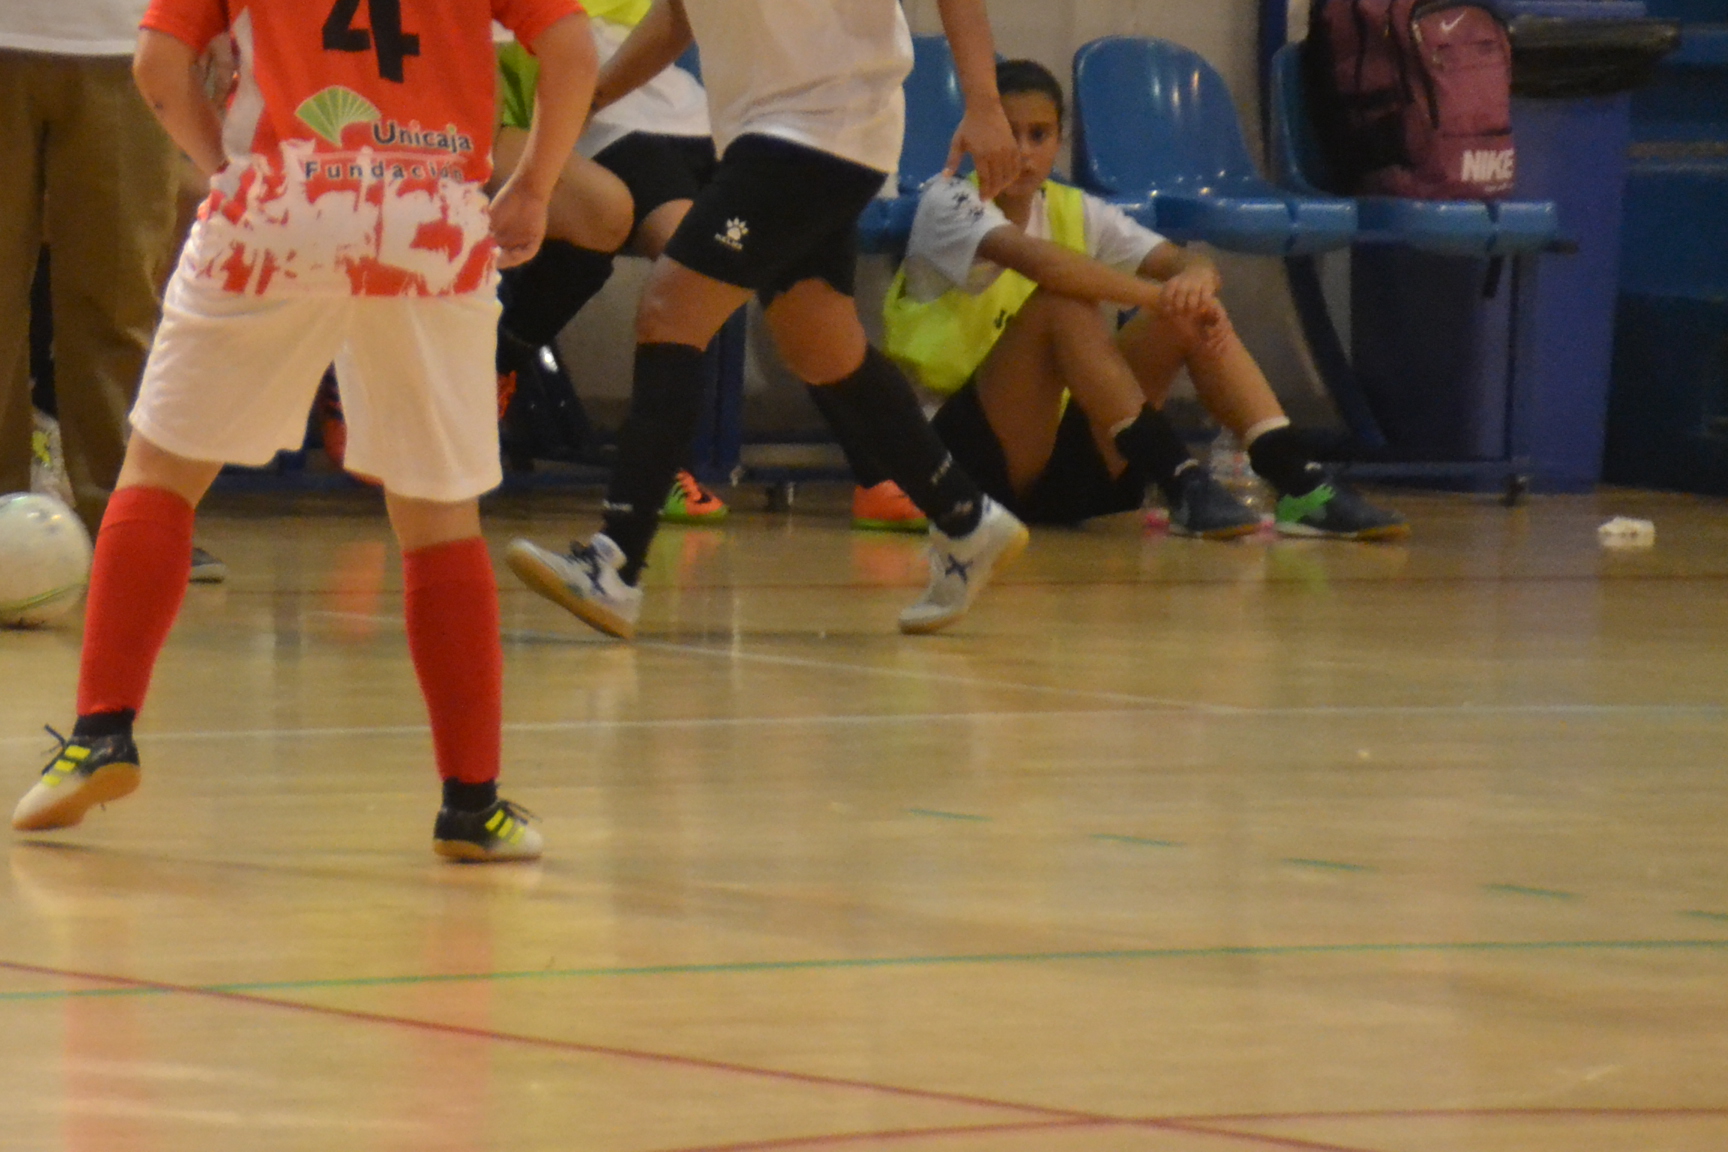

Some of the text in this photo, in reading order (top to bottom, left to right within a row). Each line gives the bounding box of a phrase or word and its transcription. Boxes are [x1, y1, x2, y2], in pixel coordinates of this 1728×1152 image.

[373, 120, 472, 154] Unicaja
[304, 159, 464, 185] Fundación
[1460, 148, 1515, 183] NIKE
